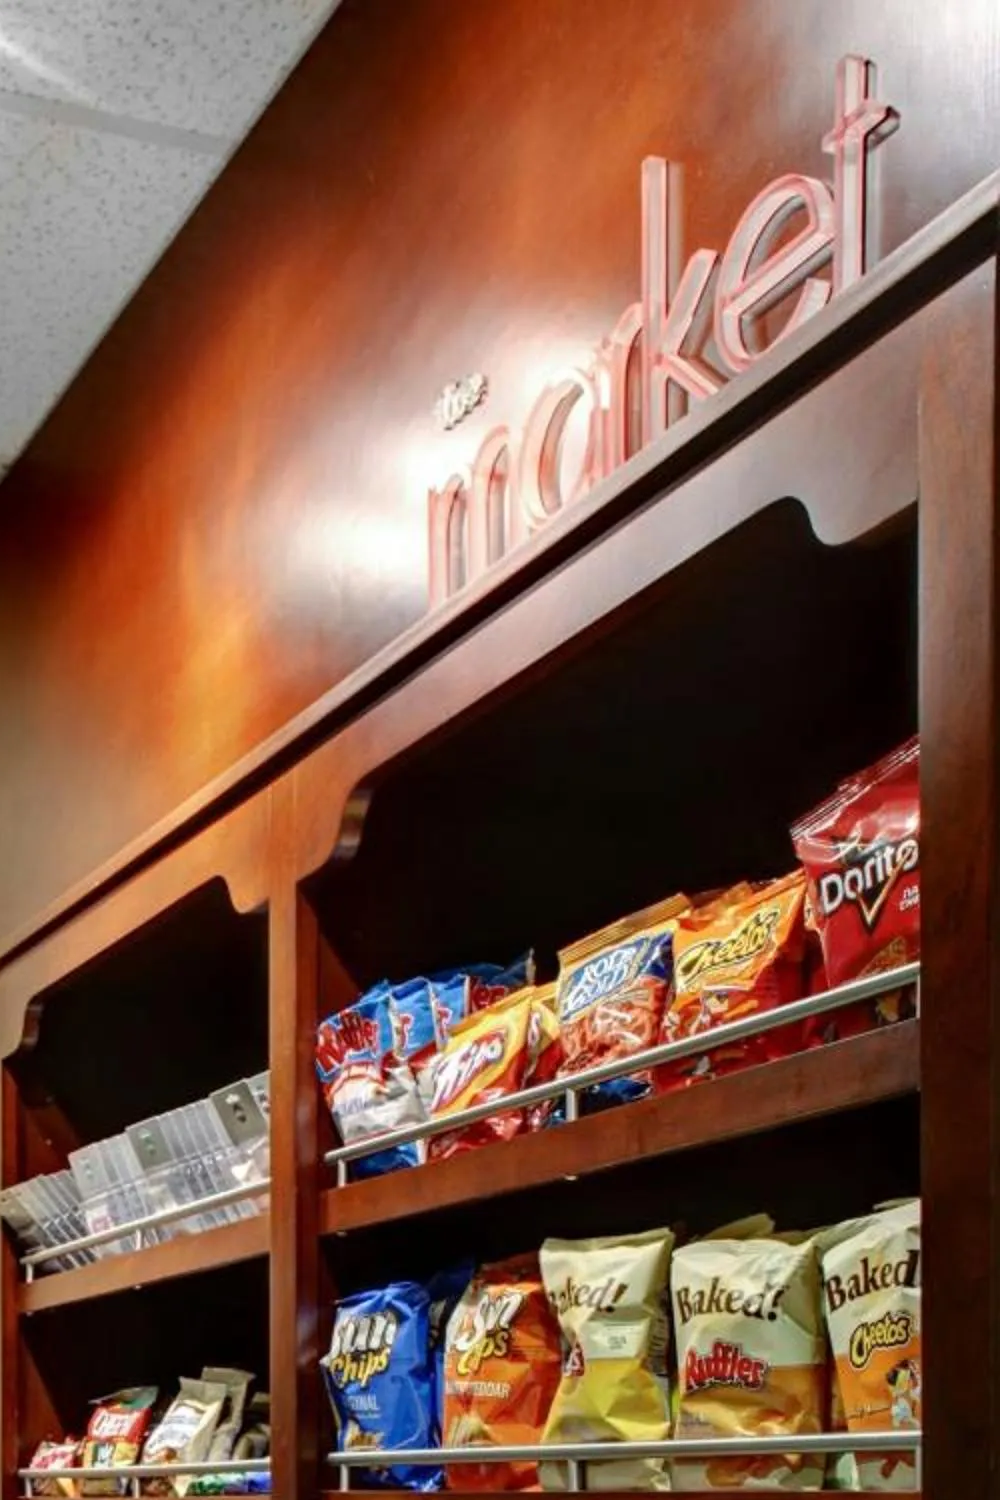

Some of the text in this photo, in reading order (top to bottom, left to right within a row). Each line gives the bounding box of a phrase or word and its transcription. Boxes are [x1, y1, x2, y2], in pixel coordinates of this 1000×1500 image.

[428, 54, 901, 614] market
[820, 838, 920, 915] Dorito
[676, 1276, 788, 1325] Baked!
[826, 1249, 920, 1312] Baked
[685, 1339, 768, 1393] Ruffles
[850, 1311, 910, 1369] Cheetos
